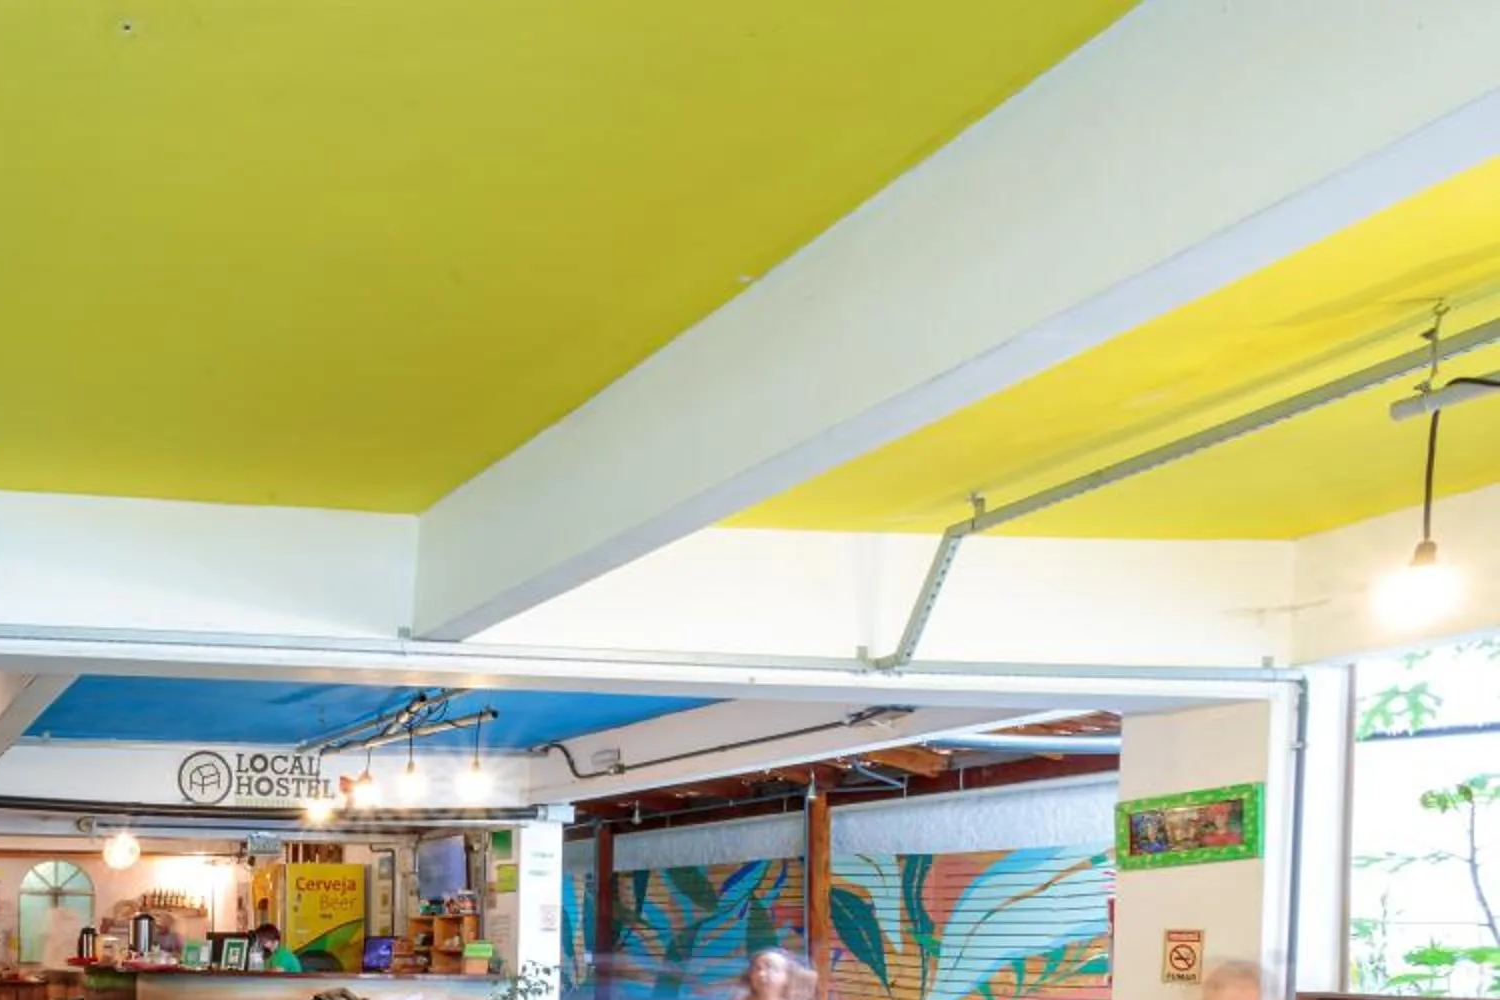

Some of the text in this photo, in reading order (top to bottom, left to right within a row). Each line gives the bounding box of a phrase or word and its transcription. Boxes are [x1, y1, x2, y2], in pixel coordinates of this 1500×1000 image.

[236, 753, 320, 776] LOCAL
[236, 776, 335, 799] HOSTEL
[295, 876, 357, 896] Cerveja
[320, 894, 357, 911] Beer
